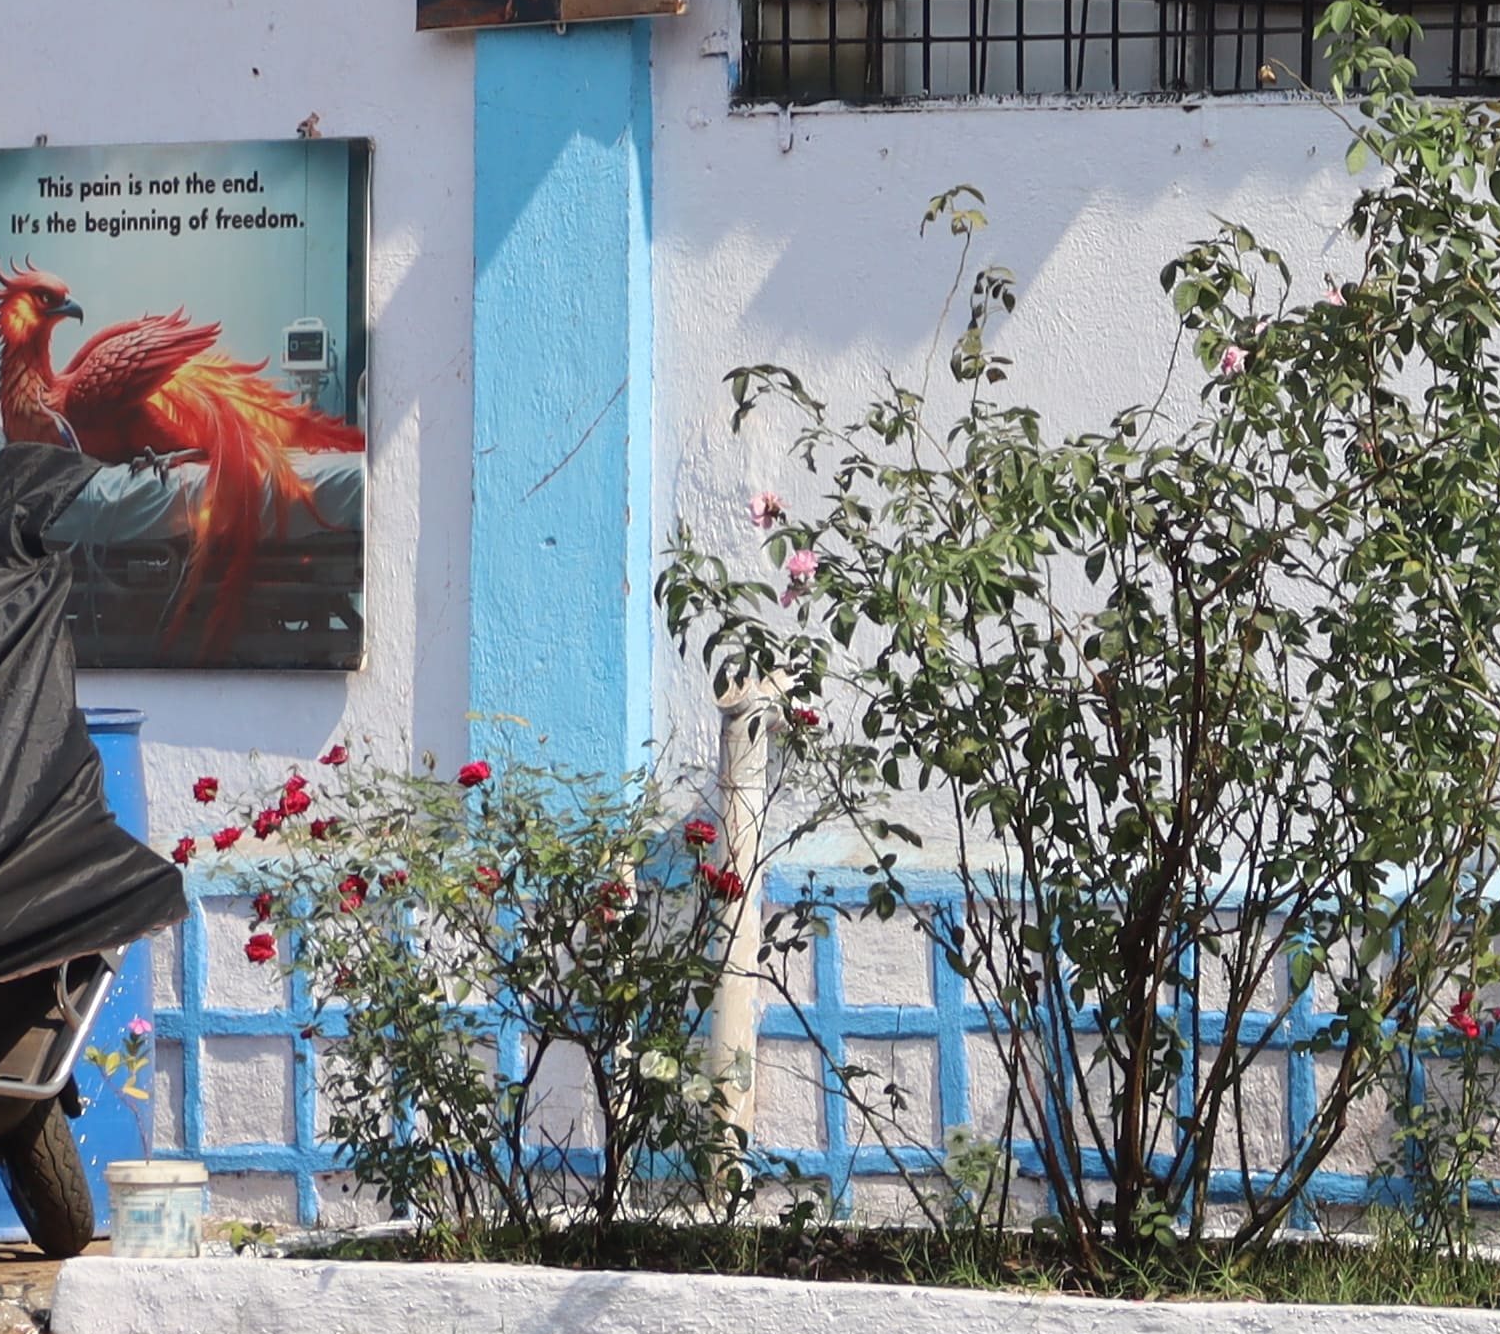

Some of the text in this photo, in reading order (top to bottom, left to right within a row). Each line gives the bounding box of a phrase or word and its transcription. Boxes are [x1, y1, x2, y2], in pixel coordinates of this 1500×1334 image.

[38, 171, 265, 202] This pain is not the end.
[11, 209, 305, 237] It's the beginning of freedom.
